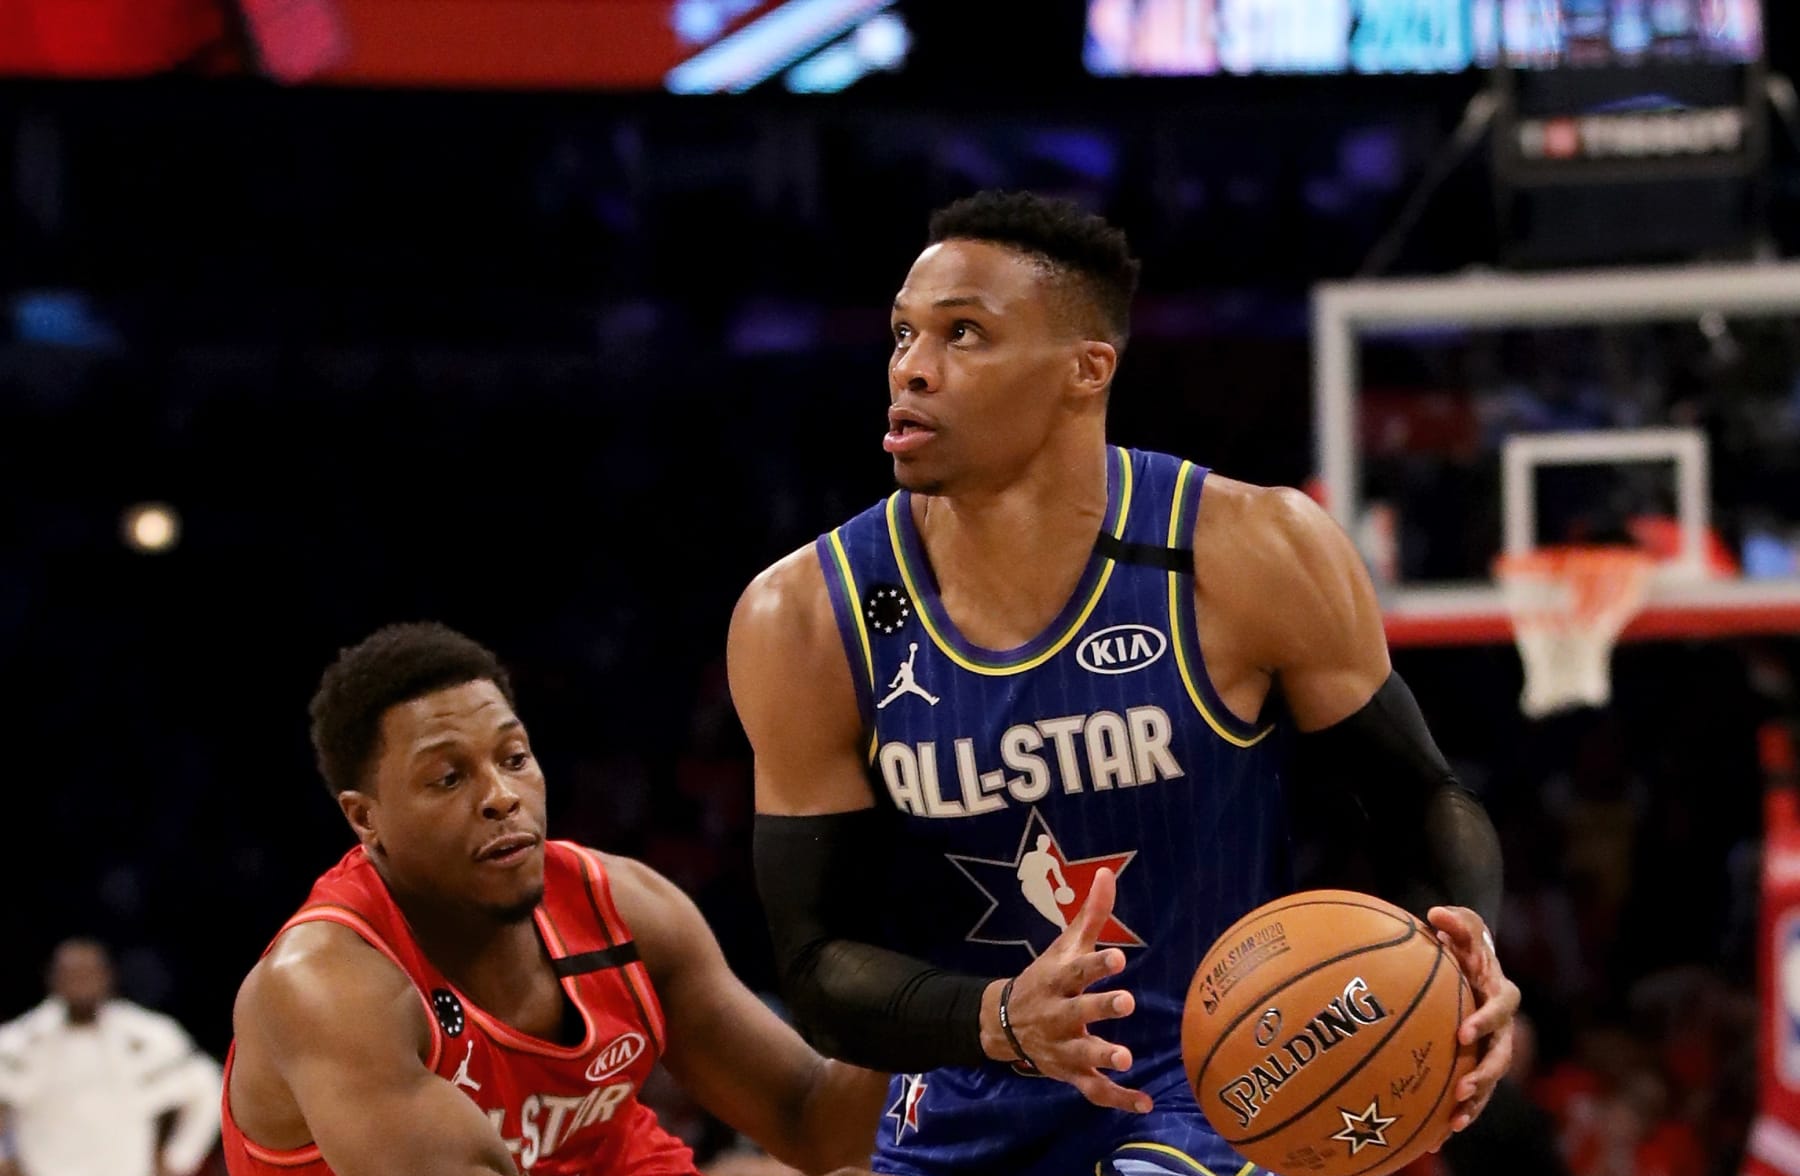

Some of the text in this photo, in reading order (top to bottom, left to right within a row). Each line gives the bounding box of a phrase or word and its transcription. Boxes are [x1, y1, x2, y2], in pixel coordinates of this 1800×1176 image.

[1090, 633, 1154, 667] KIA
[879, 705, 1185, 818] ALL-STAR
[593, 1039, 633, 1076] KIA
[1218, 976, 1387, 1129] SPALDING
